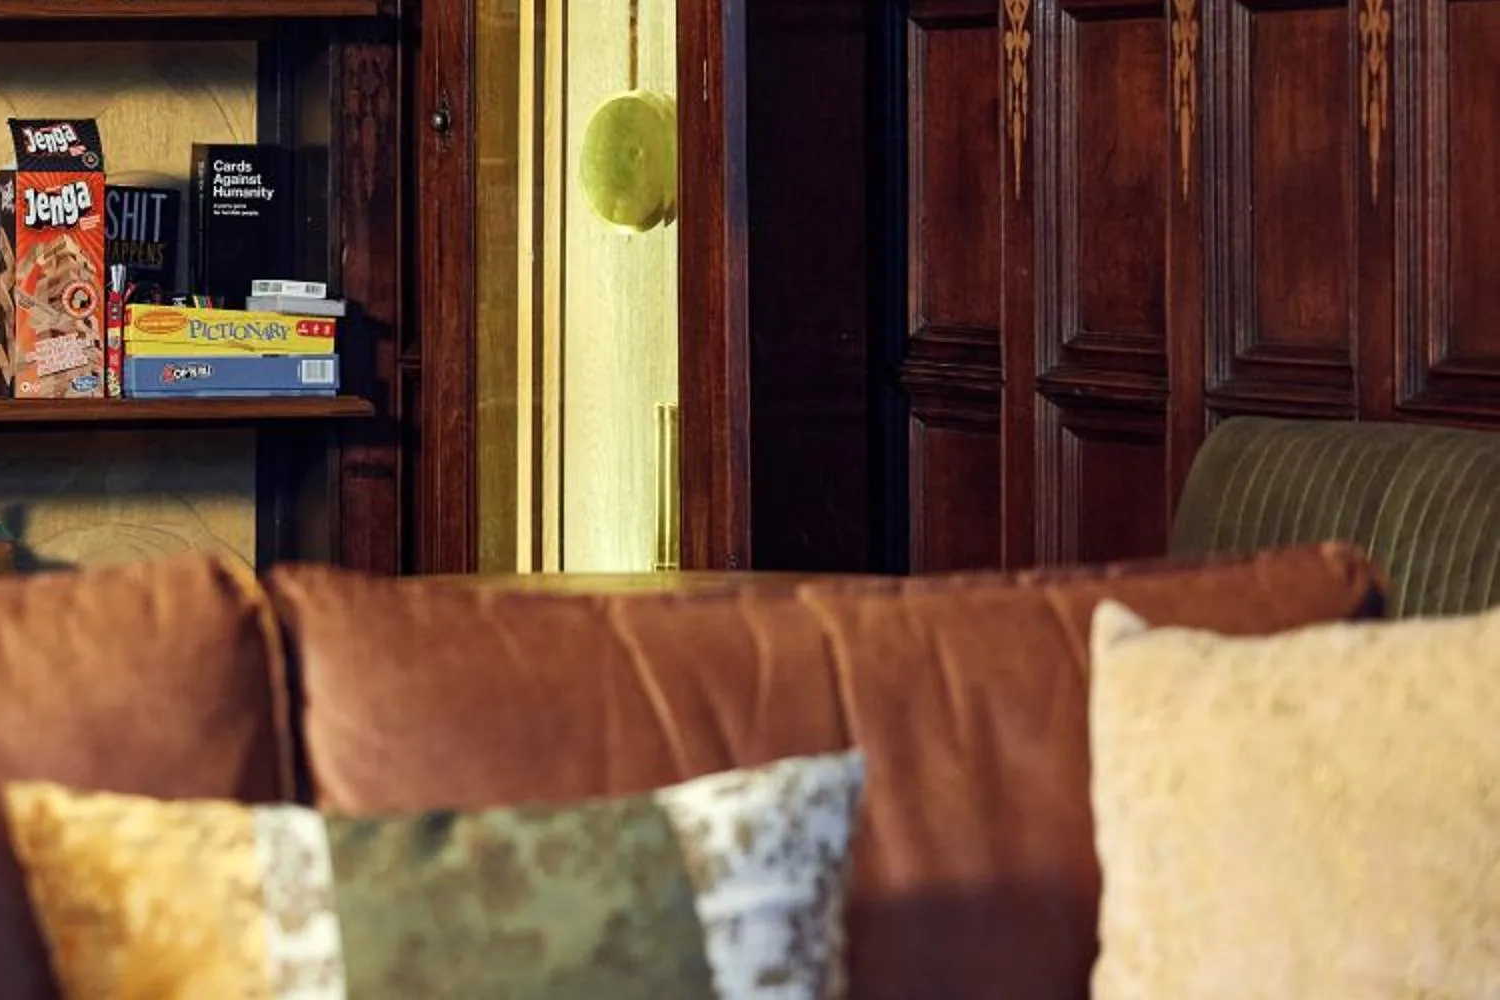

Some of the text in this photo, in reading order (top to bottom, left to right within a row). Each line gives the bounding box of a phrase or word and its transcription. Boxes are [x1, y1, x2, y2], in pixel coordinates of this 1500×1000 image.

[23, 124, 77, 153] Jenga
[213, 159, 253, 172] Cards
[213, 173, 262, 187] Against
[24, 181, 92, 226] Jenga
[213, 186, 275, 201] Humanity
[105, 189, 168, 242] SHIT
[188, 318, 291, 341] PICTIONARY
